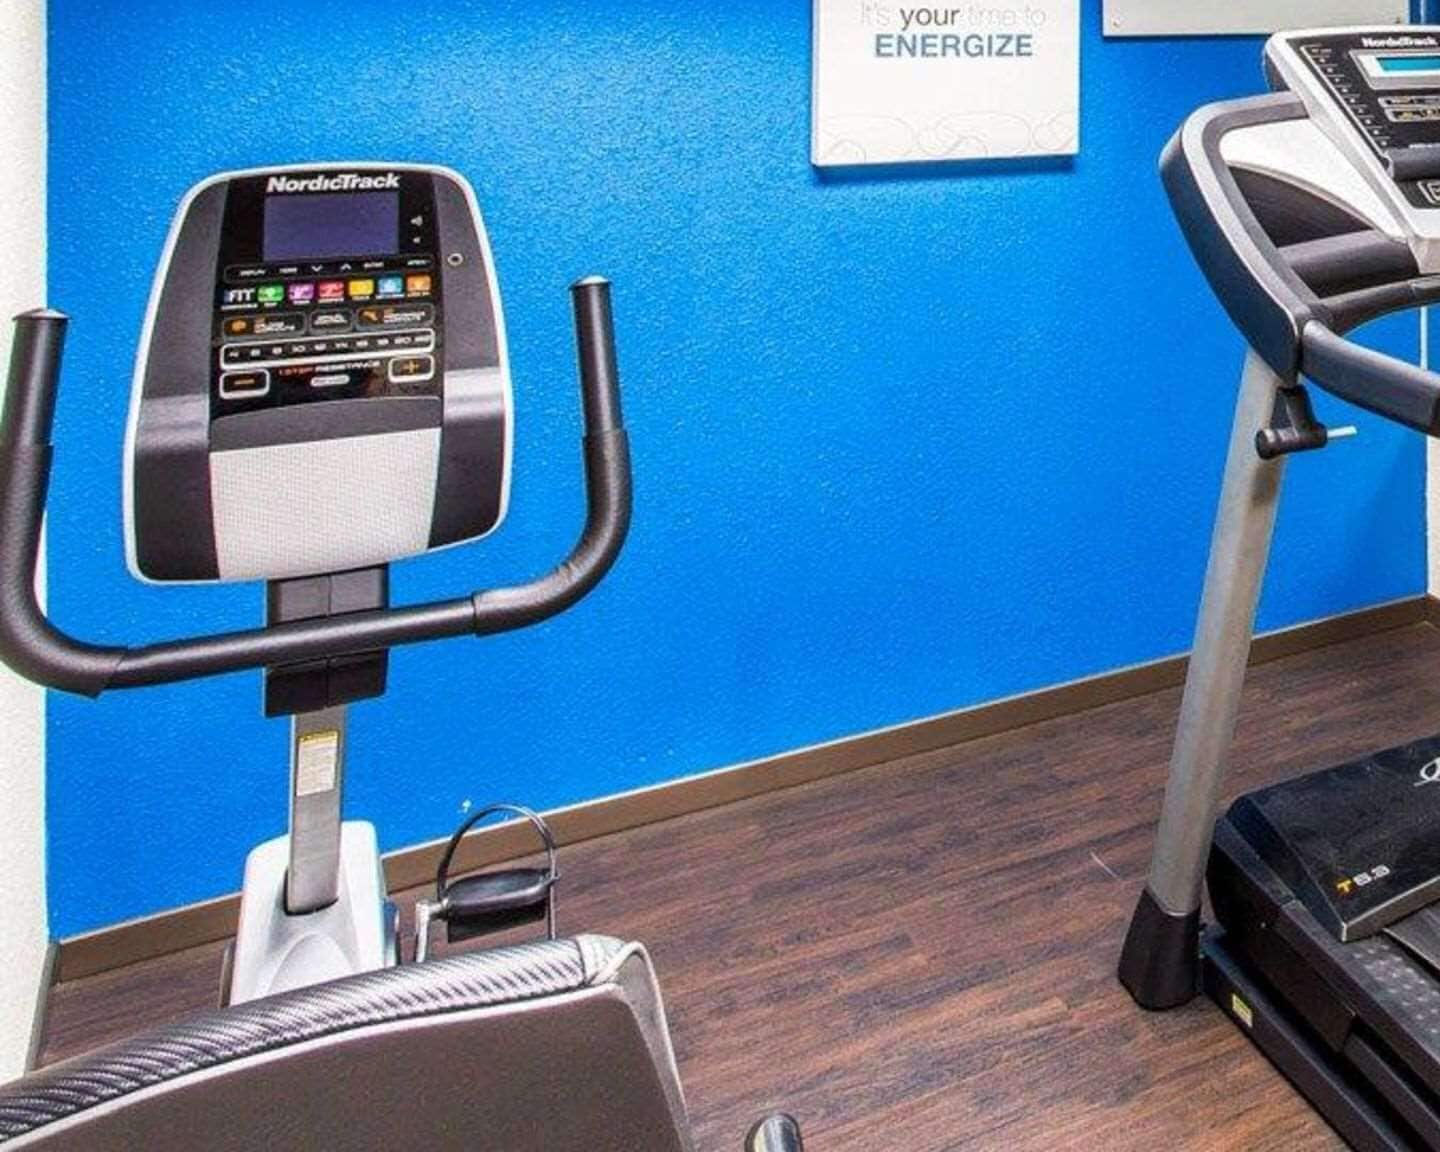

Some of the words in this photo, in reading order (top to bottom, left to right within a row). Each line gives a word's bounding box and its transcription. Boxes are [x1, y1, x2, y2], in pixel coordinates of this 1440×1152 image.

[900, 6, 960, 31] your
[874, 33, 1034, 58] ENERGIZE
[267, 173, 400, 193] NordicTrack
